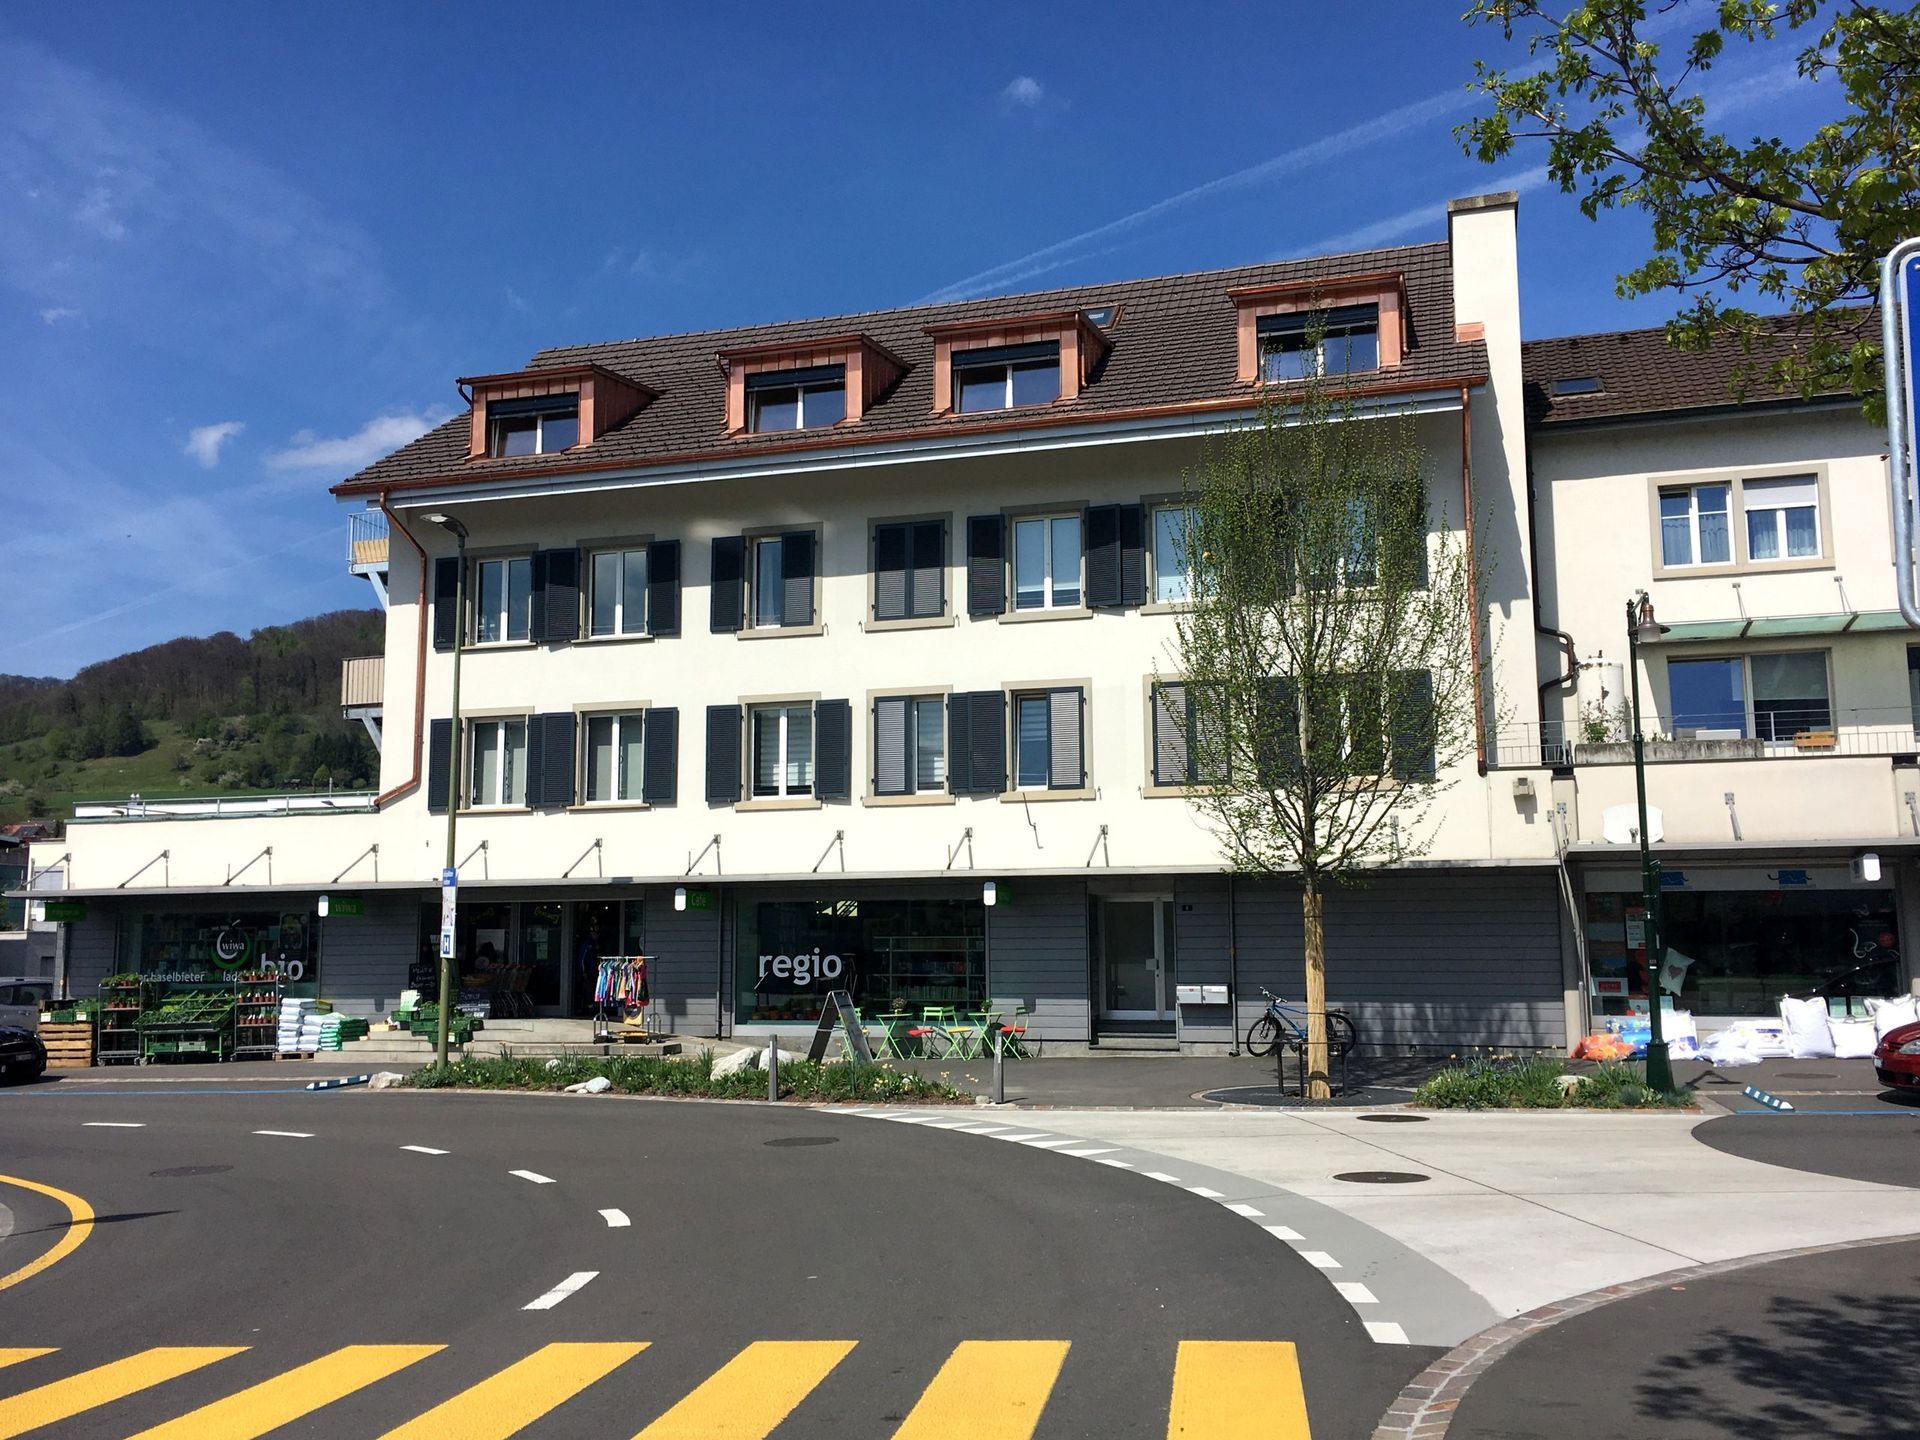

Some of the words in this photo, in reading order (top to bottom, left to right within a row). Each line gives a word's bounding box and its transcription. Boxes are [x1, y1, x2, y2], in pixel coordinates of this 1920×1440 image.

[221, 939, 245, 951] wiwa
[260, 953, 304, 981] bio
[759, 947, 842, 985] regio
[150, 970, 206, 983] baselbieter
